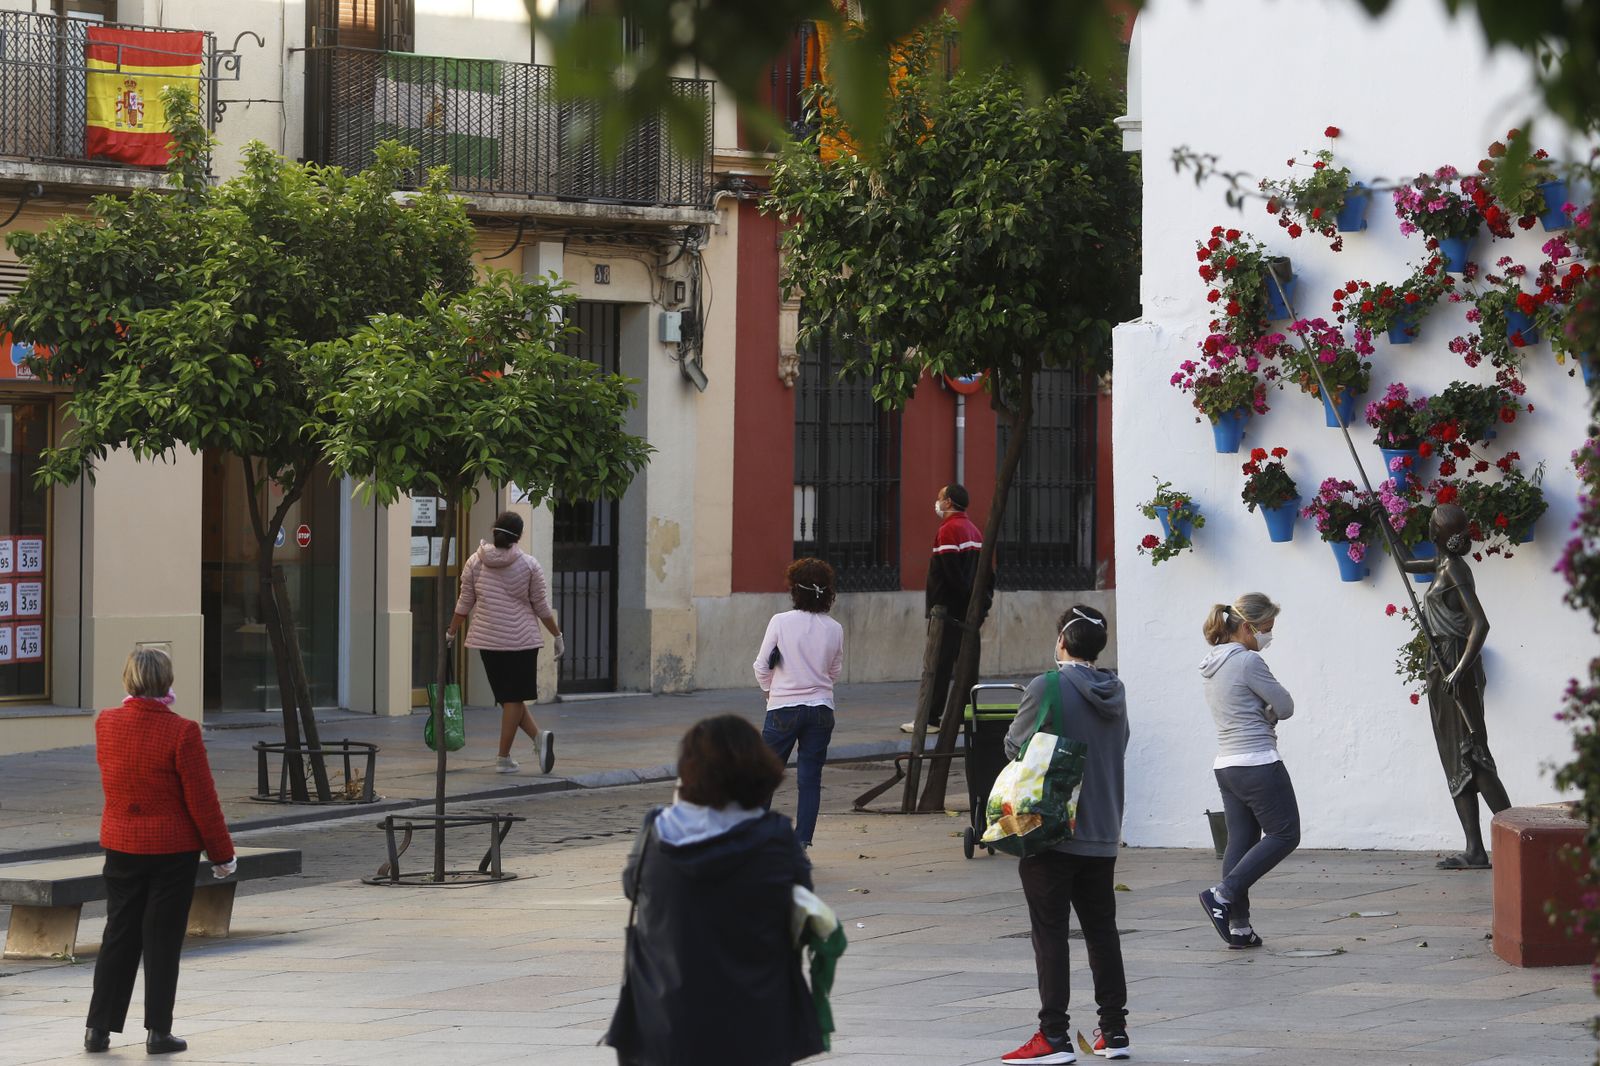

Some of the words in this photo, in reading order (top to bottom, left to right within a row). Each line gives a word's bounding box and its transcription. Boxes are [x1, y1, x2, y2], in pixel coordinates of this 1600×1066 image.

[22, 553, 38, 568] 3,95
[21, 596, 37, 611] 3,95
[21, 639, 37, 655] 4,59
[1213, 908, 1223, 919] N
